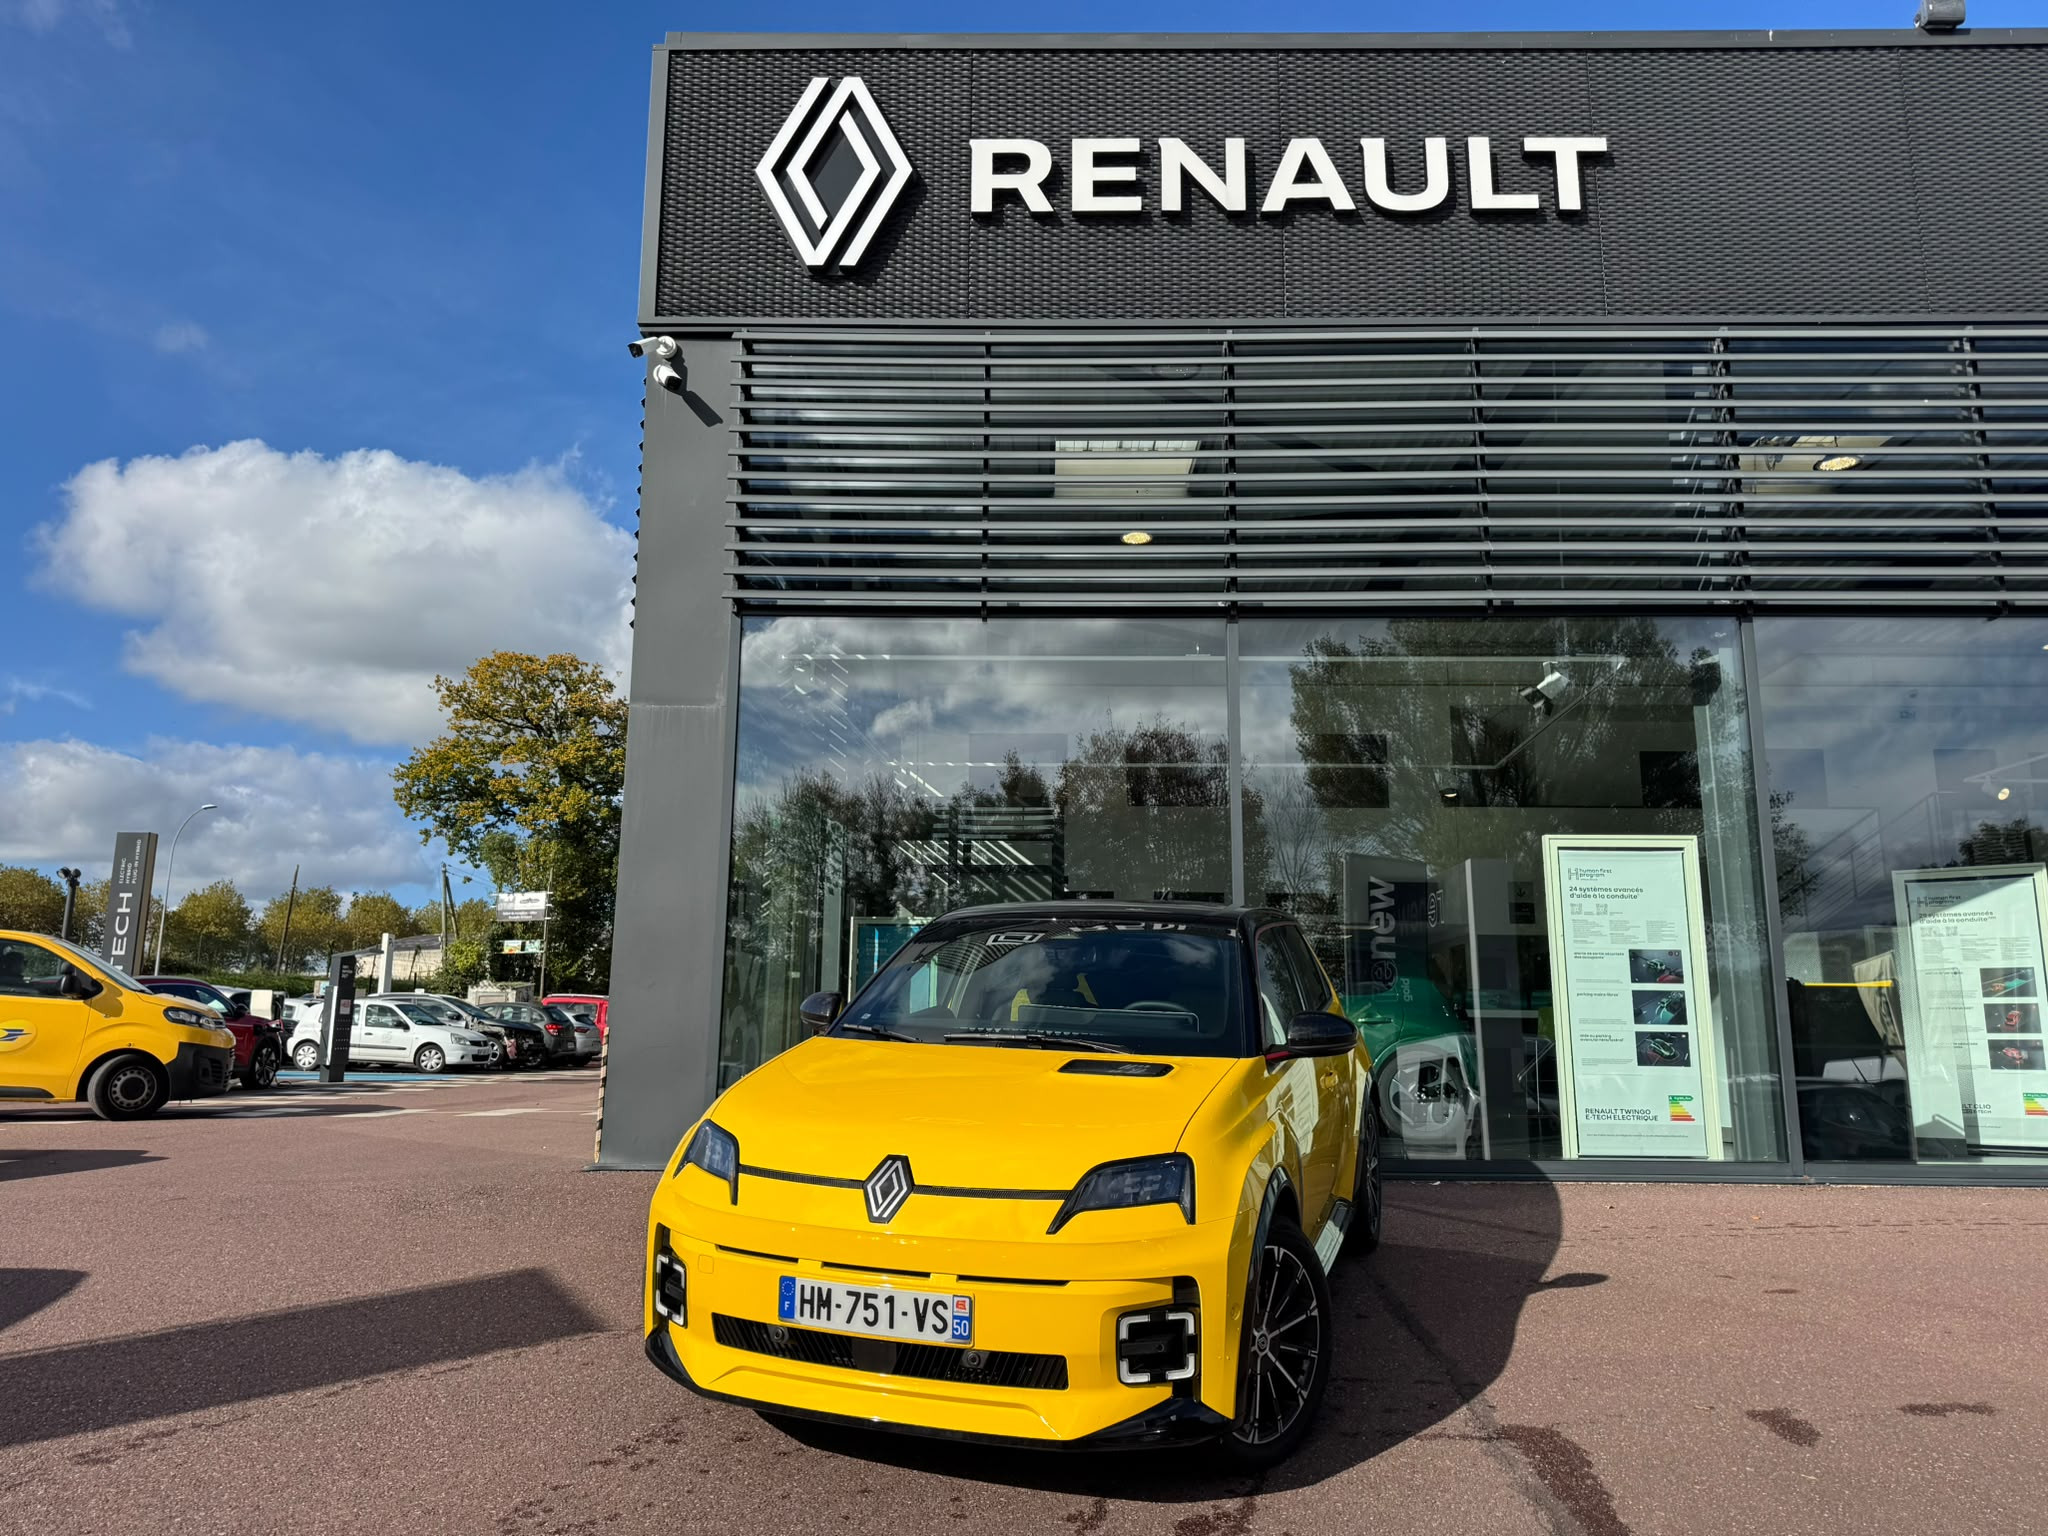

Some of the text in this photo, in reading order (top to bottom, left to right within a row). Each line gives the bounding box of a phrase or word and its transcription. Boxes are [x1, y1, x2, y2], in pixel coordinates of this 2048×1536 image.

[969, 137, 1608, 214] RENAULT
[118, 857, 127, 884] ELECTRIC
[125, 862, 133, 884] HYBRID
[131, 861, 139, 884] PLUG-IN
[1400, 977, 1413, 1002] gold
[784, 1300, 790, 1312] F
[799, 1284, 949, 1335] HM-751-VS
[953, 1319, 969, 1336] 50
